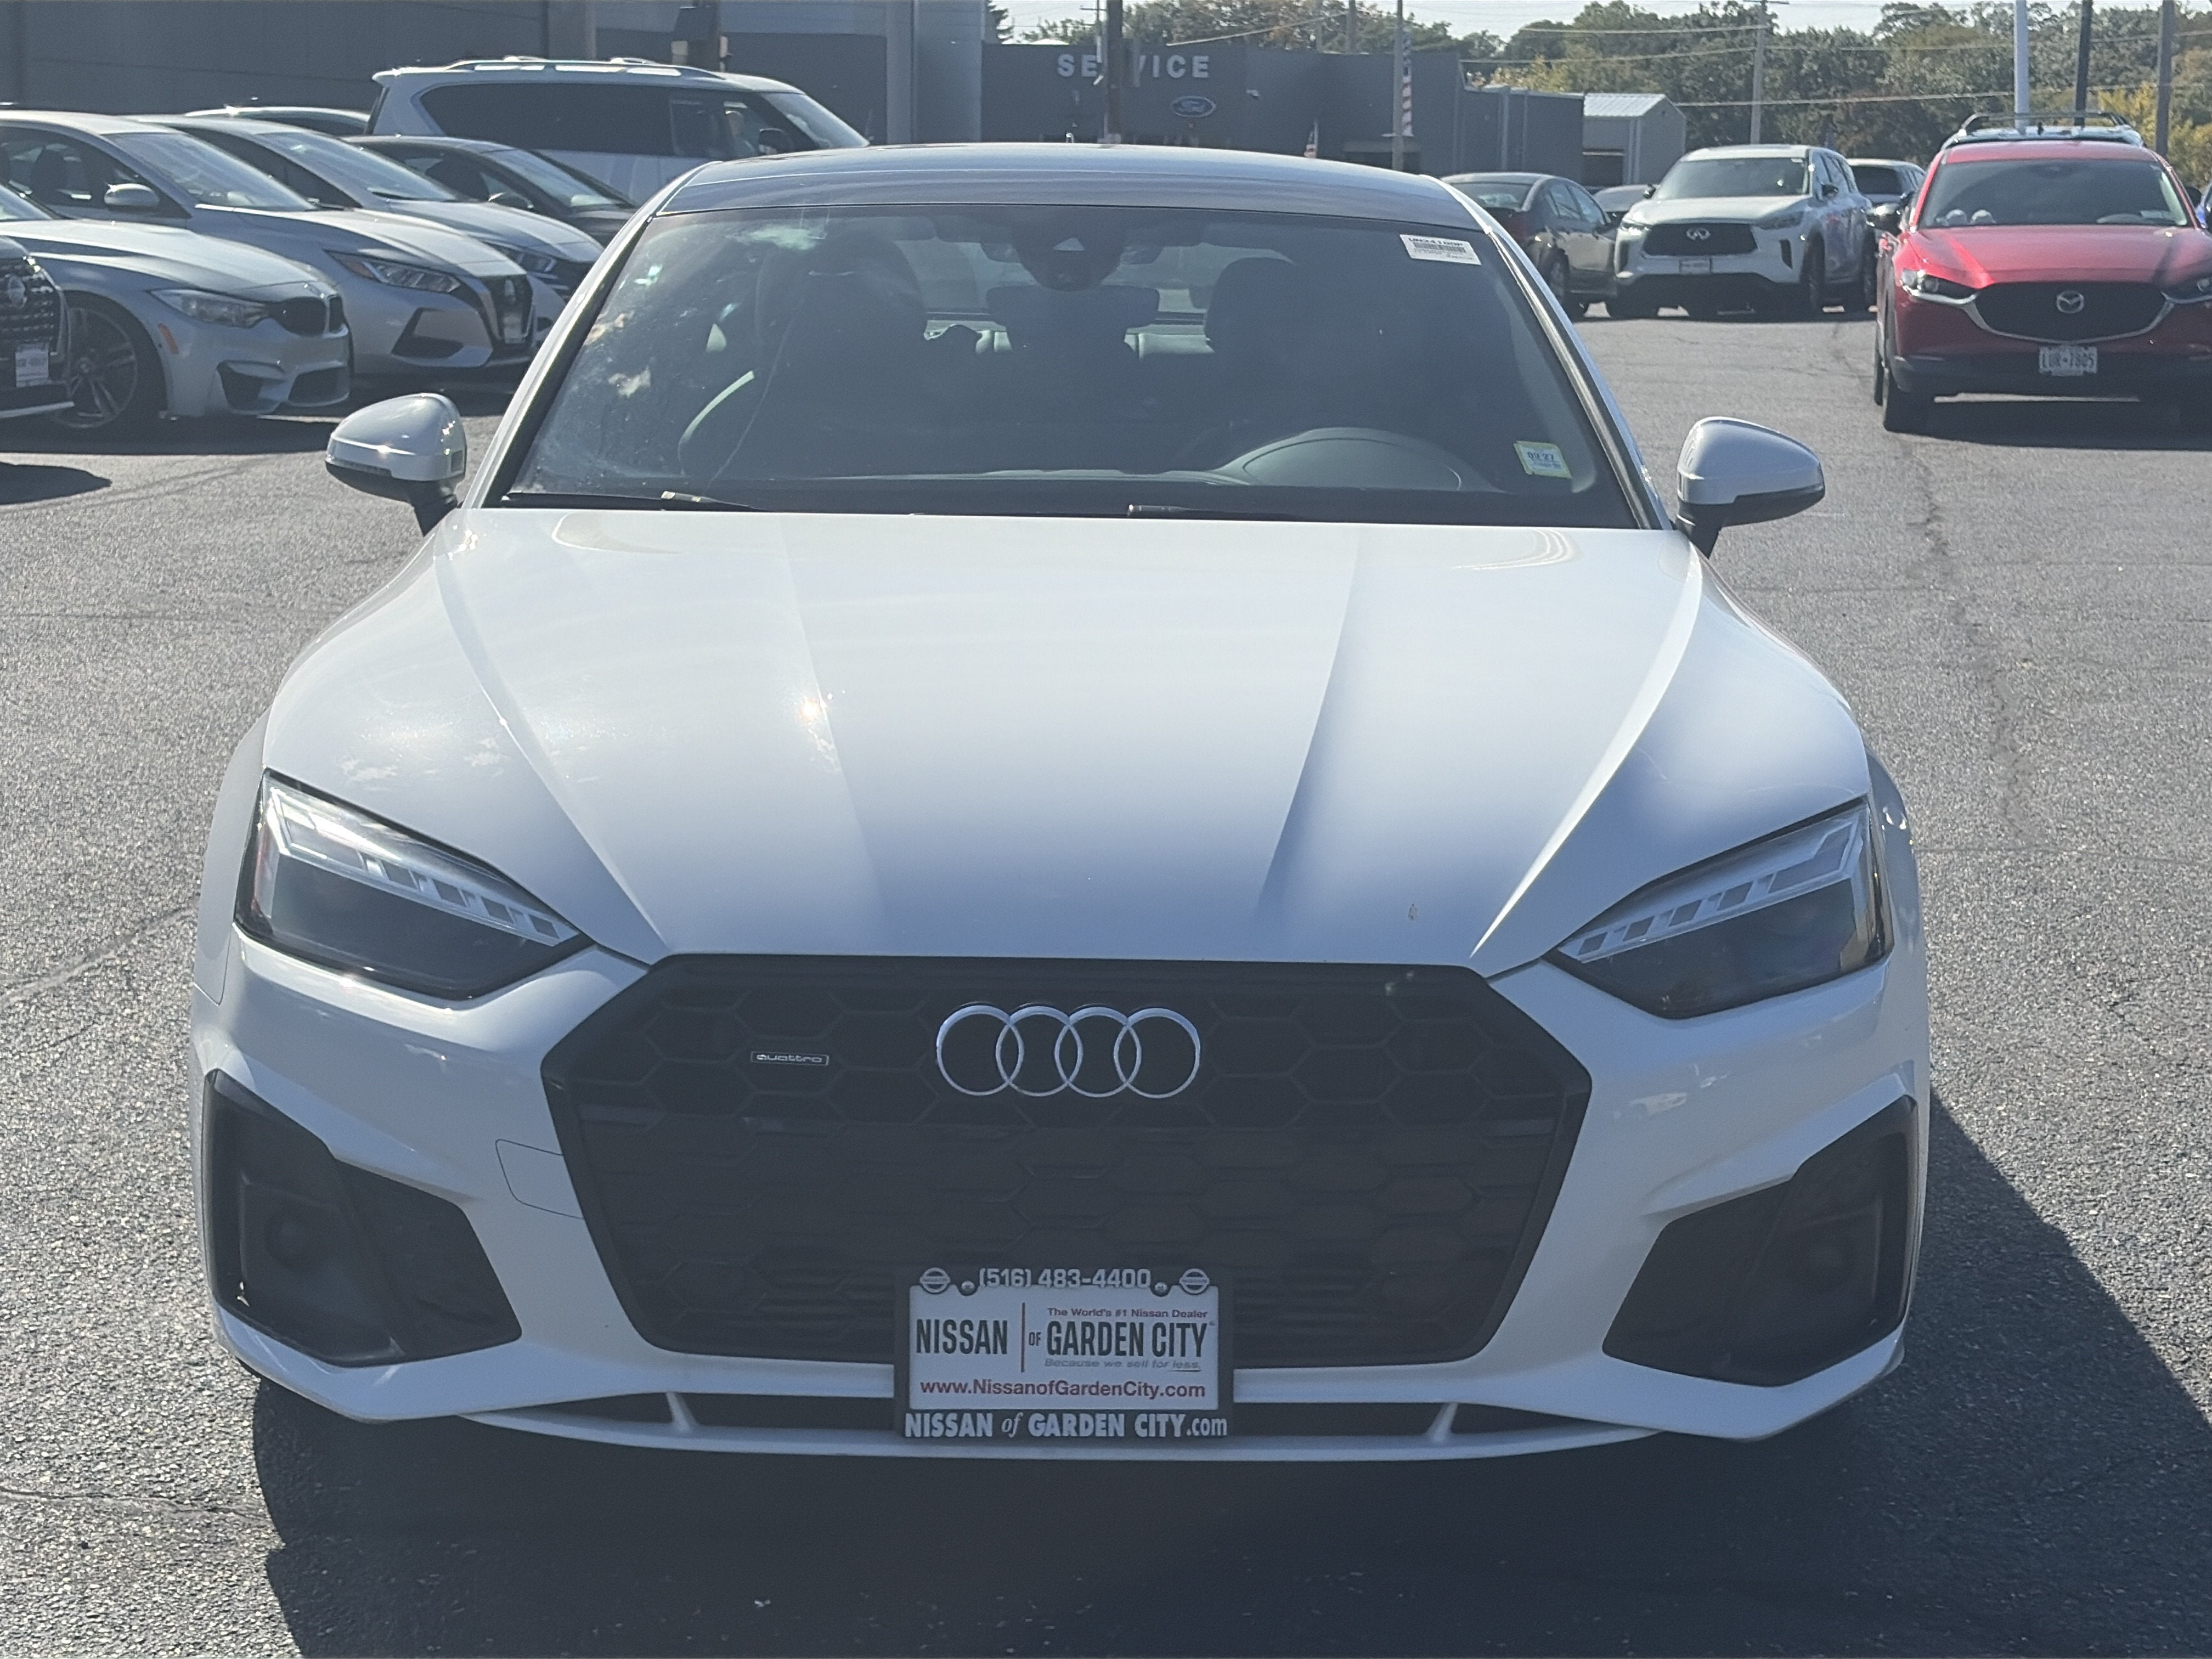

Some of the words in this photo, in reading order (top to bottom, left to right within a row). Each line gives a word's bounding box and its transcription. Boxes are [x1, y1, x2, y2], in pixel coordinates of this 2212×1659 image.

[1057, 54, 1209, 78] SEICE
[756, 1054, 822, 1063] quattro
[979, 1268, 1031, 1287] (516)
[1039, 1269, 1151, 1288] 483-4400
[1047, 1308, 1068, 1316] The
[1071, 1308, 1111, 1317] World's
[1172, 1310, 1207, 1318] Dealer
[916, 1319, 1007, 1355] NISSAN
[1029, 1332, 1041, 1346] OF
[1047, 1321, 1144, 1356] GARDEN
[1152, 1322, 1207, 1357] CITY
[1045, 1358, 1100, 1367] Because
[1126, 1359, 1149, 1368] sell
[1152, 1360, 1169, 1368] for
[920, 1379, 1205, 1400] www.NissanofGardenCity.com
[905, 1413, 993, 1437] NISSAN
[1001, 1412, 1024, 1437] of
[1028, 1413, 1125, 1437] GARDEN
